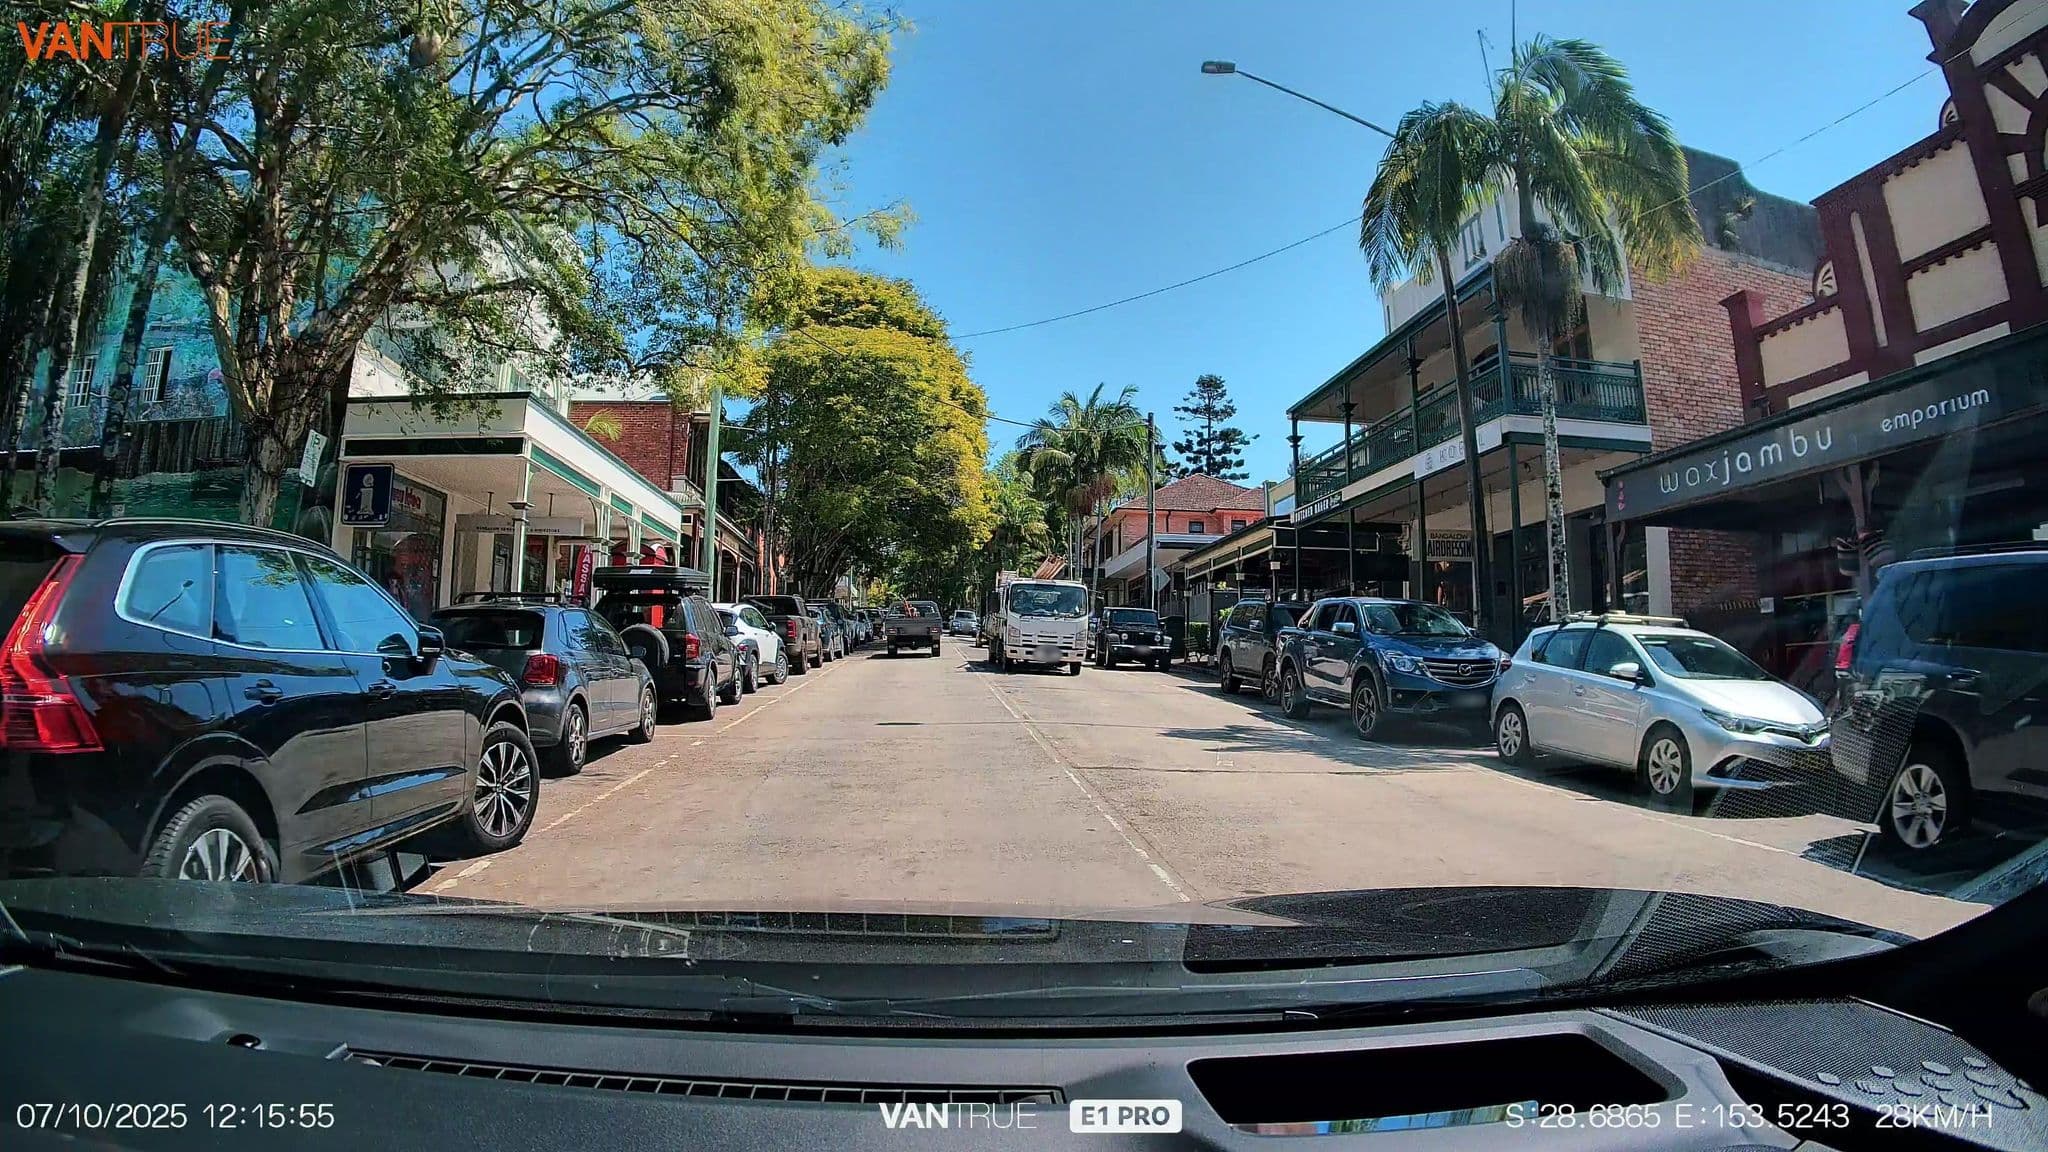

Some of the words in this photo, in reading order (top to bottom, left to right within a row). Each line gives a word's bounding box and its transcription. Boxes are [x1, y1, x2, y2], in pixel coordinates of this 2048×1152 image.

[1660, 427, 1833, 495] waxjambu
[1882, 387, 1990, 432] emporium
[578, 544, 593, 596] MASSA
